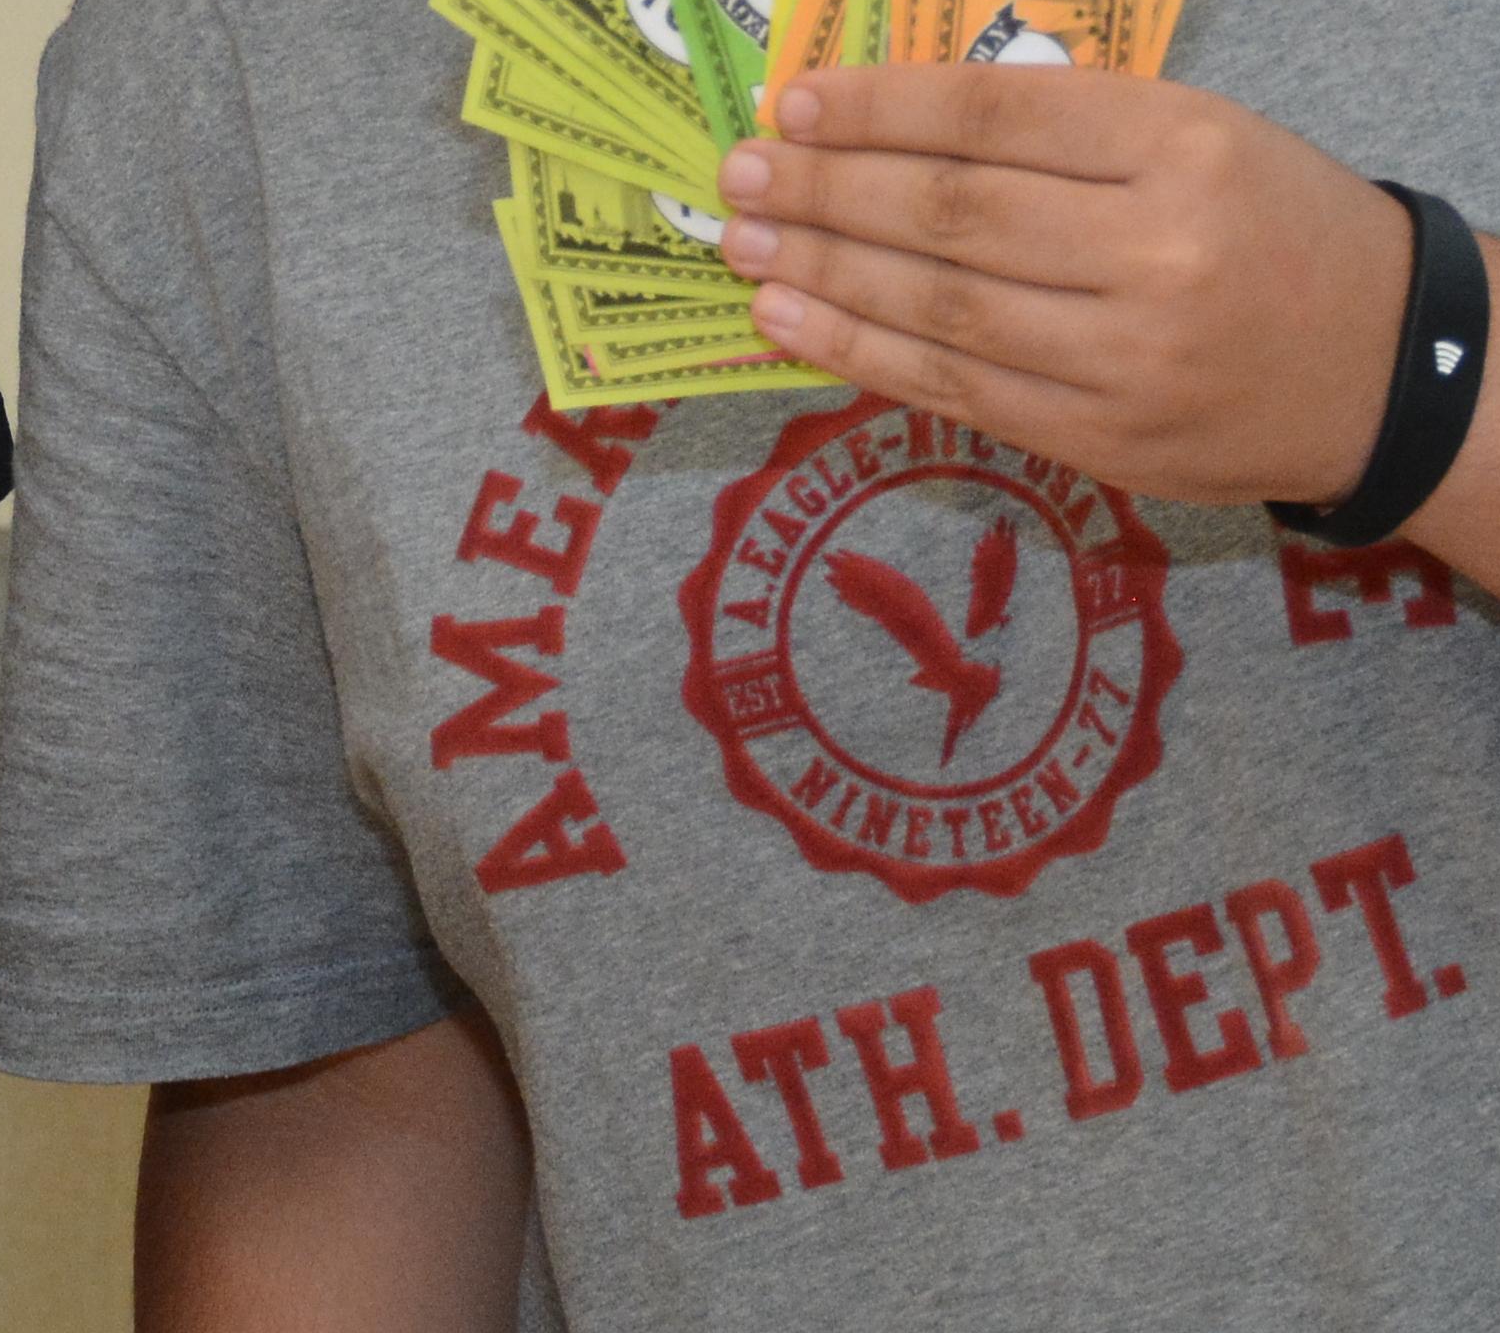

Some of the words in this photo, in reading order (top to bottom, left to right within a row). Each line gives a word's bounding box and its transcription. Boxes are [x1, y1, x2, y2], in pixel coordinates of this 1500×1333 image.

[726, 671, 784, 719] EST
[669, 985, 1024, 1220] ATH.
[1028, 833, 1468, 1122] DEPT.
